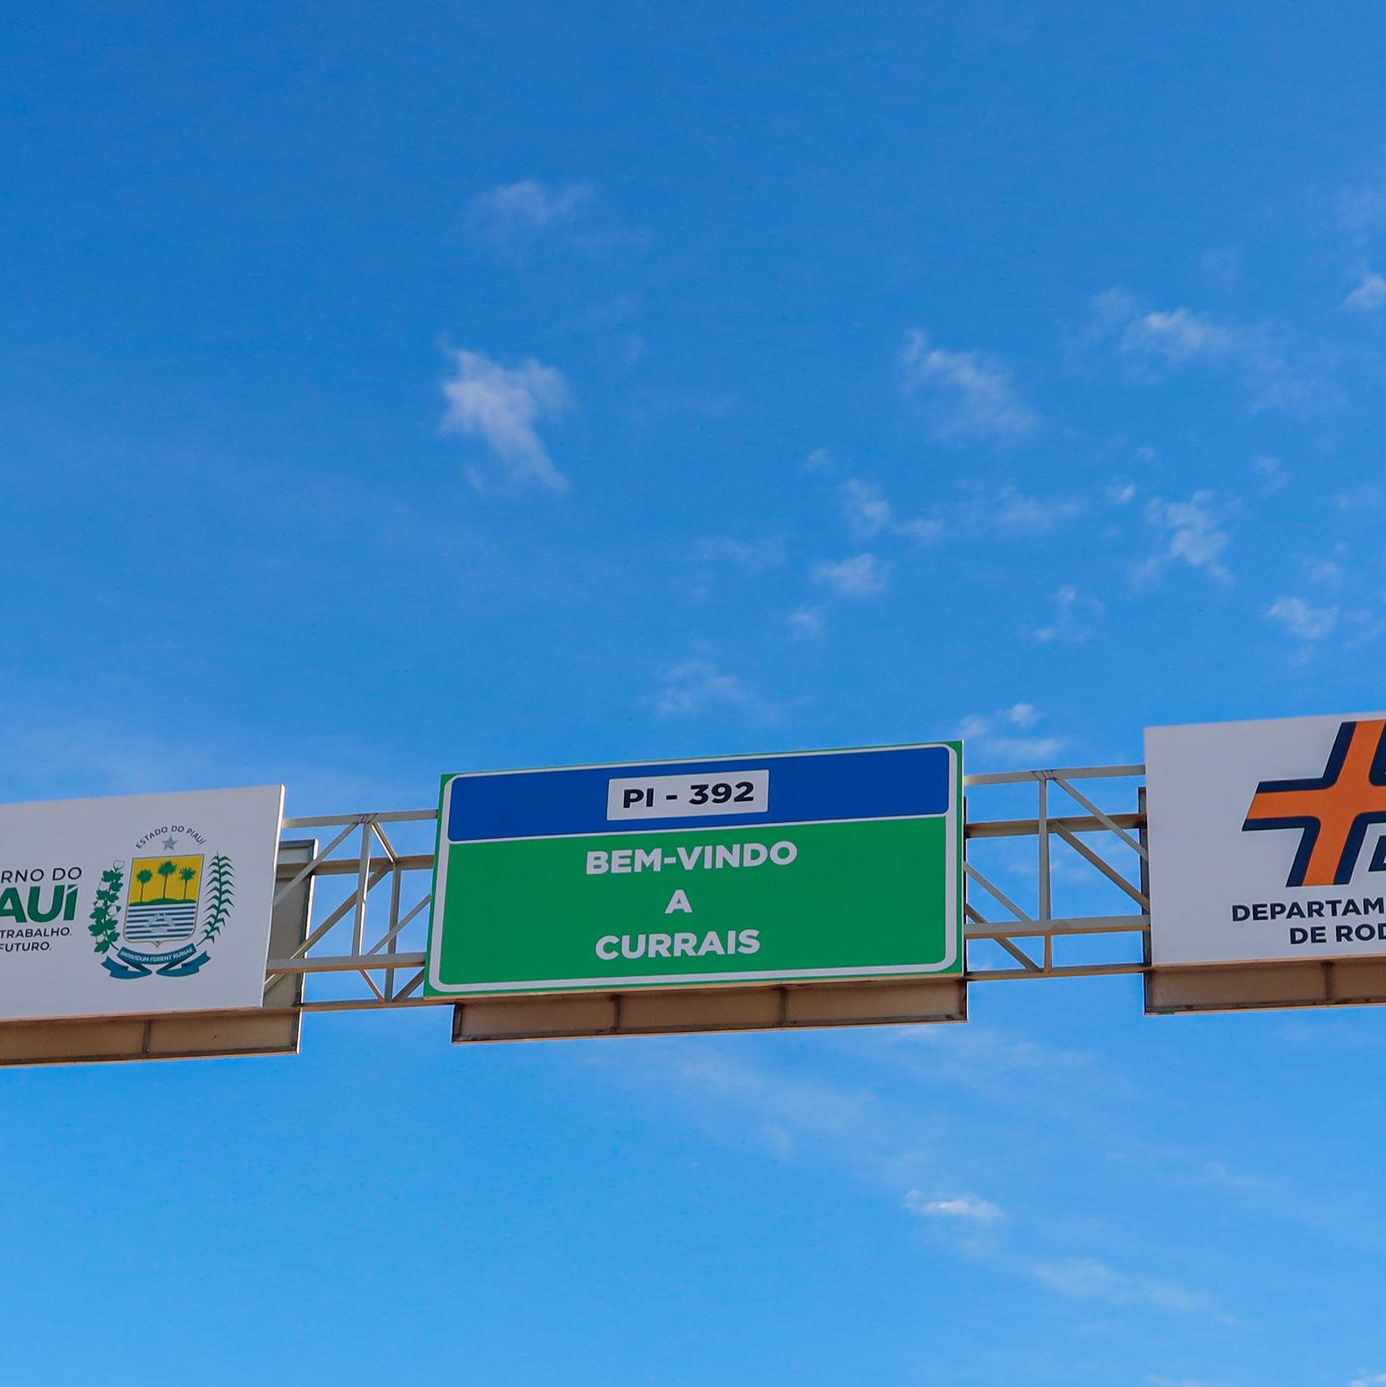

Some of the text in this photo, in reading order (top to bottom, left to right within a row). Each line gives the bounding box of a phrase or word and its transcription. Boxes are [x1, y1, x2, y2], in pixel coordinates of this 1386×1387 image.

[623, 788, 654, 808] PI
[689, 781, 754, 805] 392
[136, 826, 168, 849] ESTADO
[171, 825, 185, 833] DO
[586, 840, 798, 875] BEM-VINDO
[52, 866, 82, 882] DO
[664, 889, 693, 914] A
[0, 927, 72, 939] TRABALHO.
[595, 929, 761, 961] CURRAIS
[1289, 926, 1327, 945] DE
